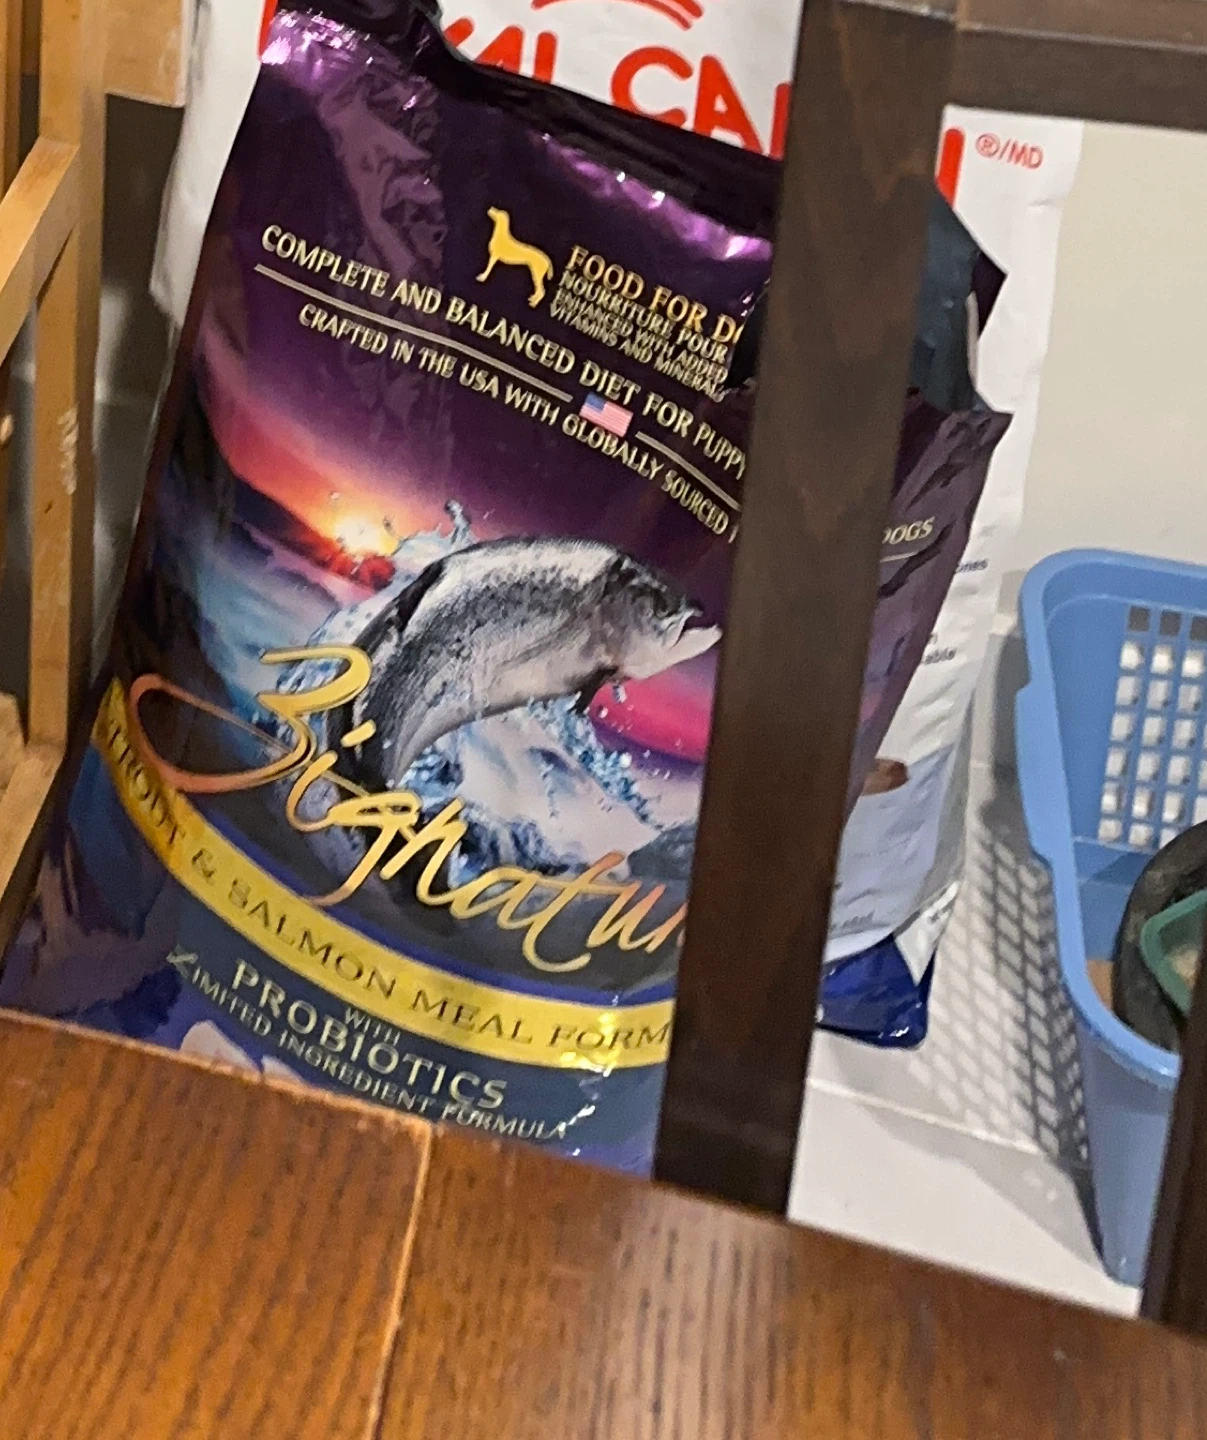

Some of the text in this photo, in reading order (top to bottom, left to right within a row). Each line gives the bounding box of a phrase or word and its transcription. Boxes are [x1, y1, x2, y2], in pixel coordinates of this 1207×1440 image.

[261, 224, 390, 298] COMPLETE
[391, 278, 442, 314] AND
[445, 296, 576, 374] BALANCED
[579, 359, 641, 406] DIET
[642, 391, 694, 438] FOR
[559, 270, 676, 339] NOURRITURE
[677, 327, 729, 364] POUR
[565, 245, 645, 300] FOOD
[649, 285, 708, 332] FOR
[618, 339, 653, 364] AND
[298, 302, 389, 355] CRAFTED
[392, 339, 416, 364] IN
[417, 346, 458, 379] THE
[460, 363, 499, 399] USA
[504, 383, 561, 426] WITH
[562, 412, 664, 481] GLOBALLY
[662, 470, 729, 535] SOURCED
[227, 878, 397, 1000] SALMON
[411, 988, 534, 1044] MEAL
[547, 1021, 673, 1051] FORM
[231, 958, 508, 1110] PROBIOTICS
[278, 1029, 437, 1115] INGREDIENT
[345, 1007, 402, 1047] WITH
